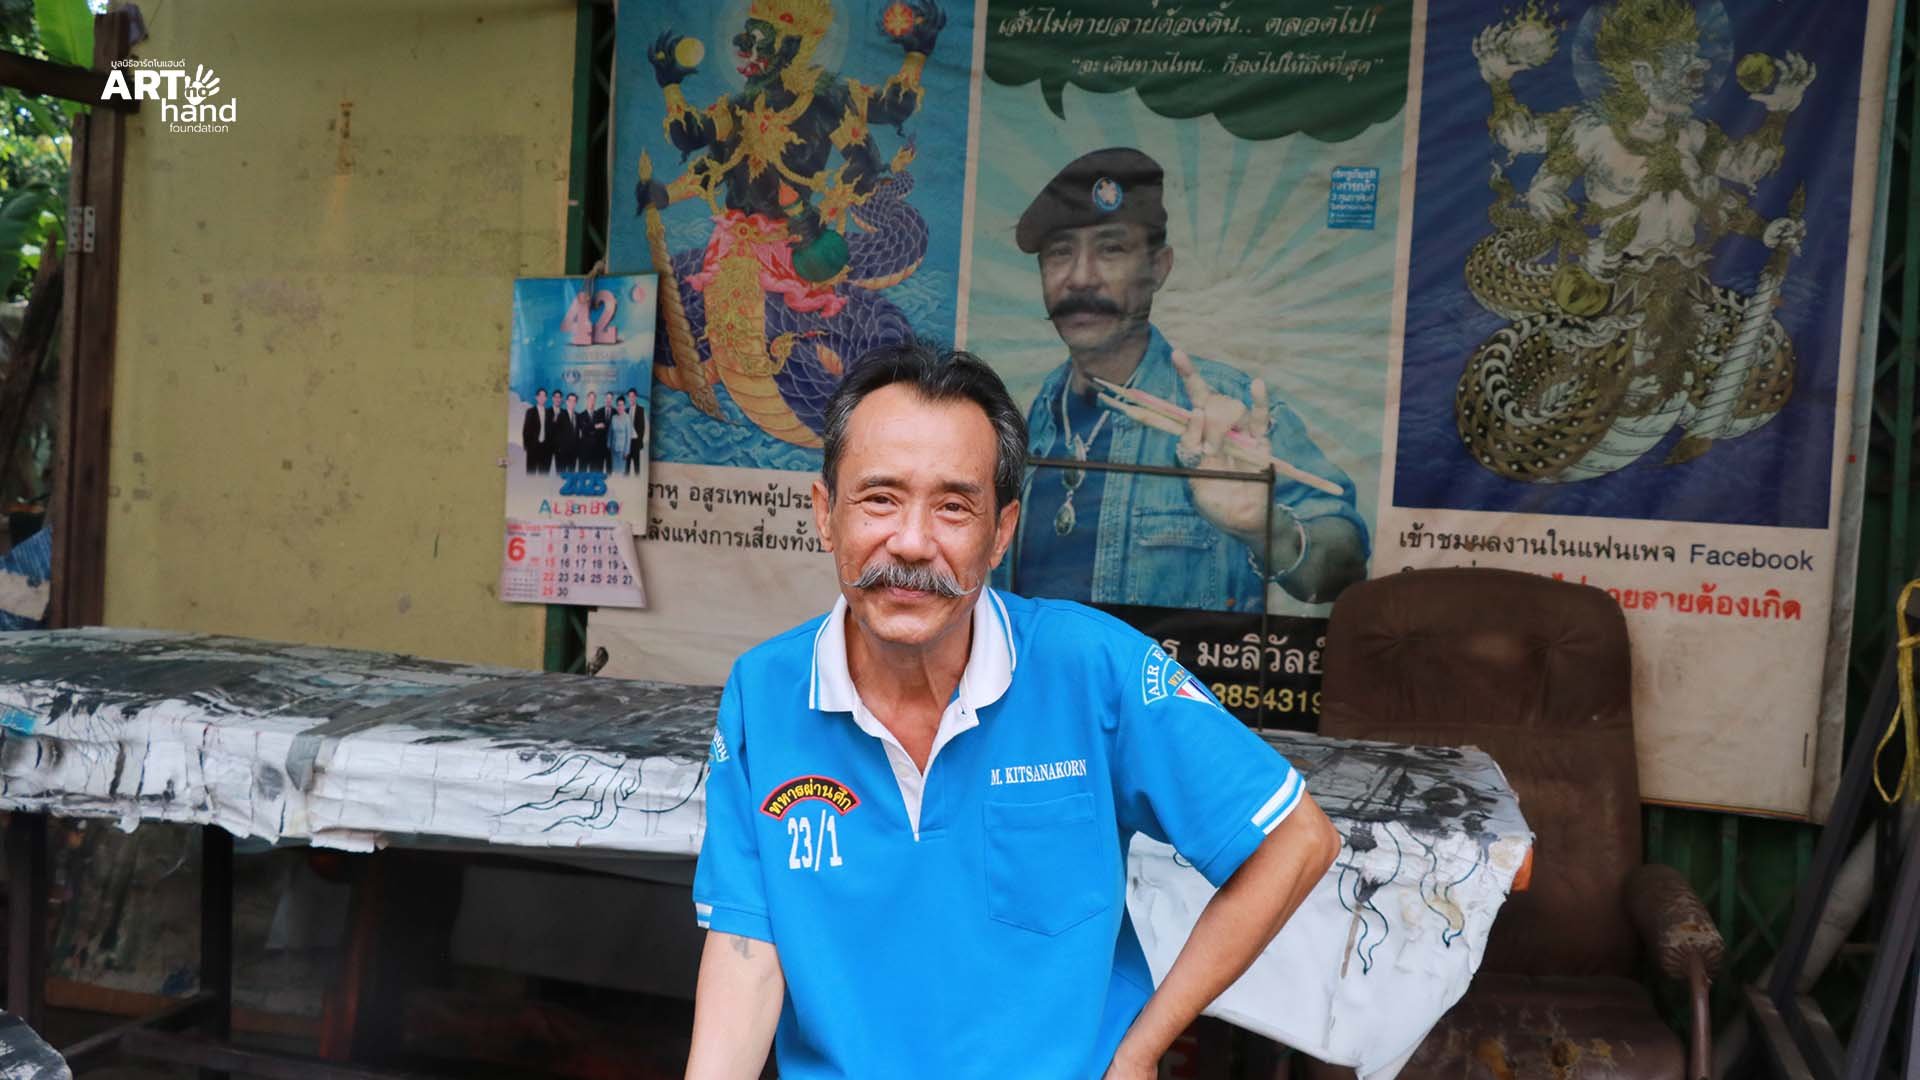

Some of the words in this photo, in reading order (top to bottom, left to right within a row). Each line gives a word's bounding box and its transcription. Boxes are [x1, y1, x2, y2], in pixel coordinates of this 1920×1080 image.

[560, 289, 618, 345] 42
[507, 535, 527, 563] 6
[576, 544, 587, 554] 10
[593, 545, 602, 555] 11
[608, 545, 618, 555] 12
[1690, 544, 1814, 571] Facebook
[560, 558, 570, 569] 16
[576, 559, 586, 569] 17
[593, 559, 603, 569] 18
[608, 560, 618, 570] 19
[557, 586, 569, 597] 30
[558, 572, 569, 583] 23
[574, 573, 585, 583] 24
[591, 574, 602, 584] 25
[607, 574, 618, 584] 26
[622, 575, 633, 585] 27
[1147, 665, 1160, 697] AIR
[991, 768, 1002, 785] M.
[1005, 759, 1087, 784] KITSANAKORN
[769, 778, 852, 816] ทหารผ่านศึก
[787, 809, 843, 872] 23/1
